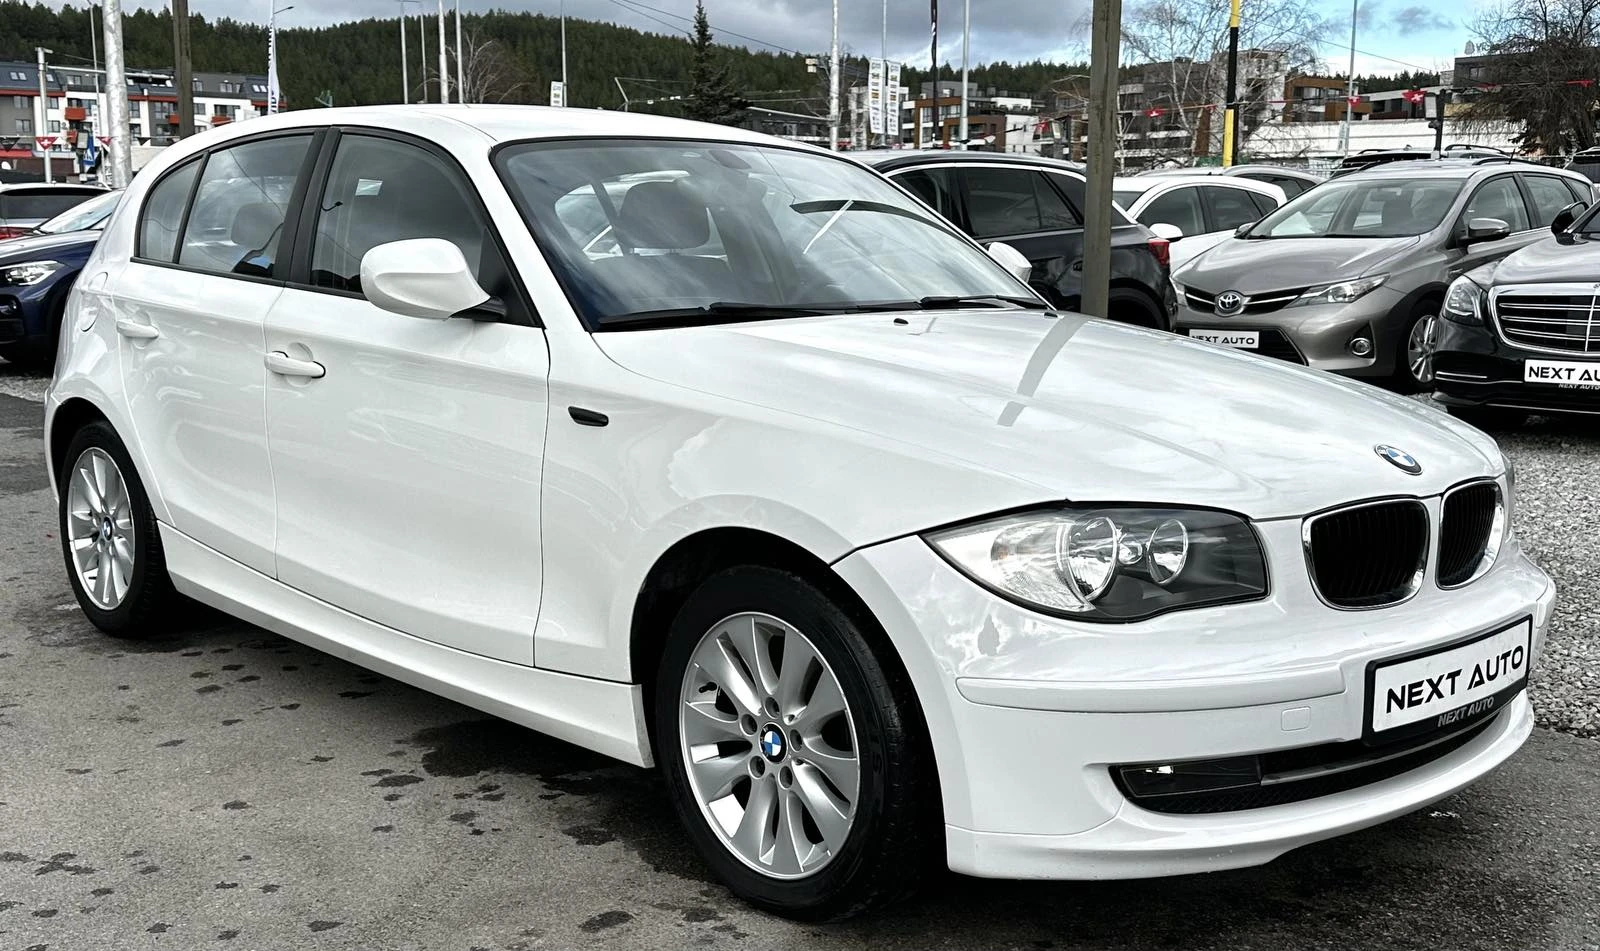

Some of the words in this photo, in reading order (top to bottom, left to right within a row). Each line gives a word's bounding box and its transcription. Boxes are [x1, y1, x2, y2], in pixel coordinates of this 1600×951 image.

[1529, 366, 1576, 380] NEXT
[1387, 669, 1462, 714] NEXT
[1467, 645, 1524, 690] AUTO
[1438, 706, 1468, 727] NEXT
[1469, 696, 1495, 714] AUTO
